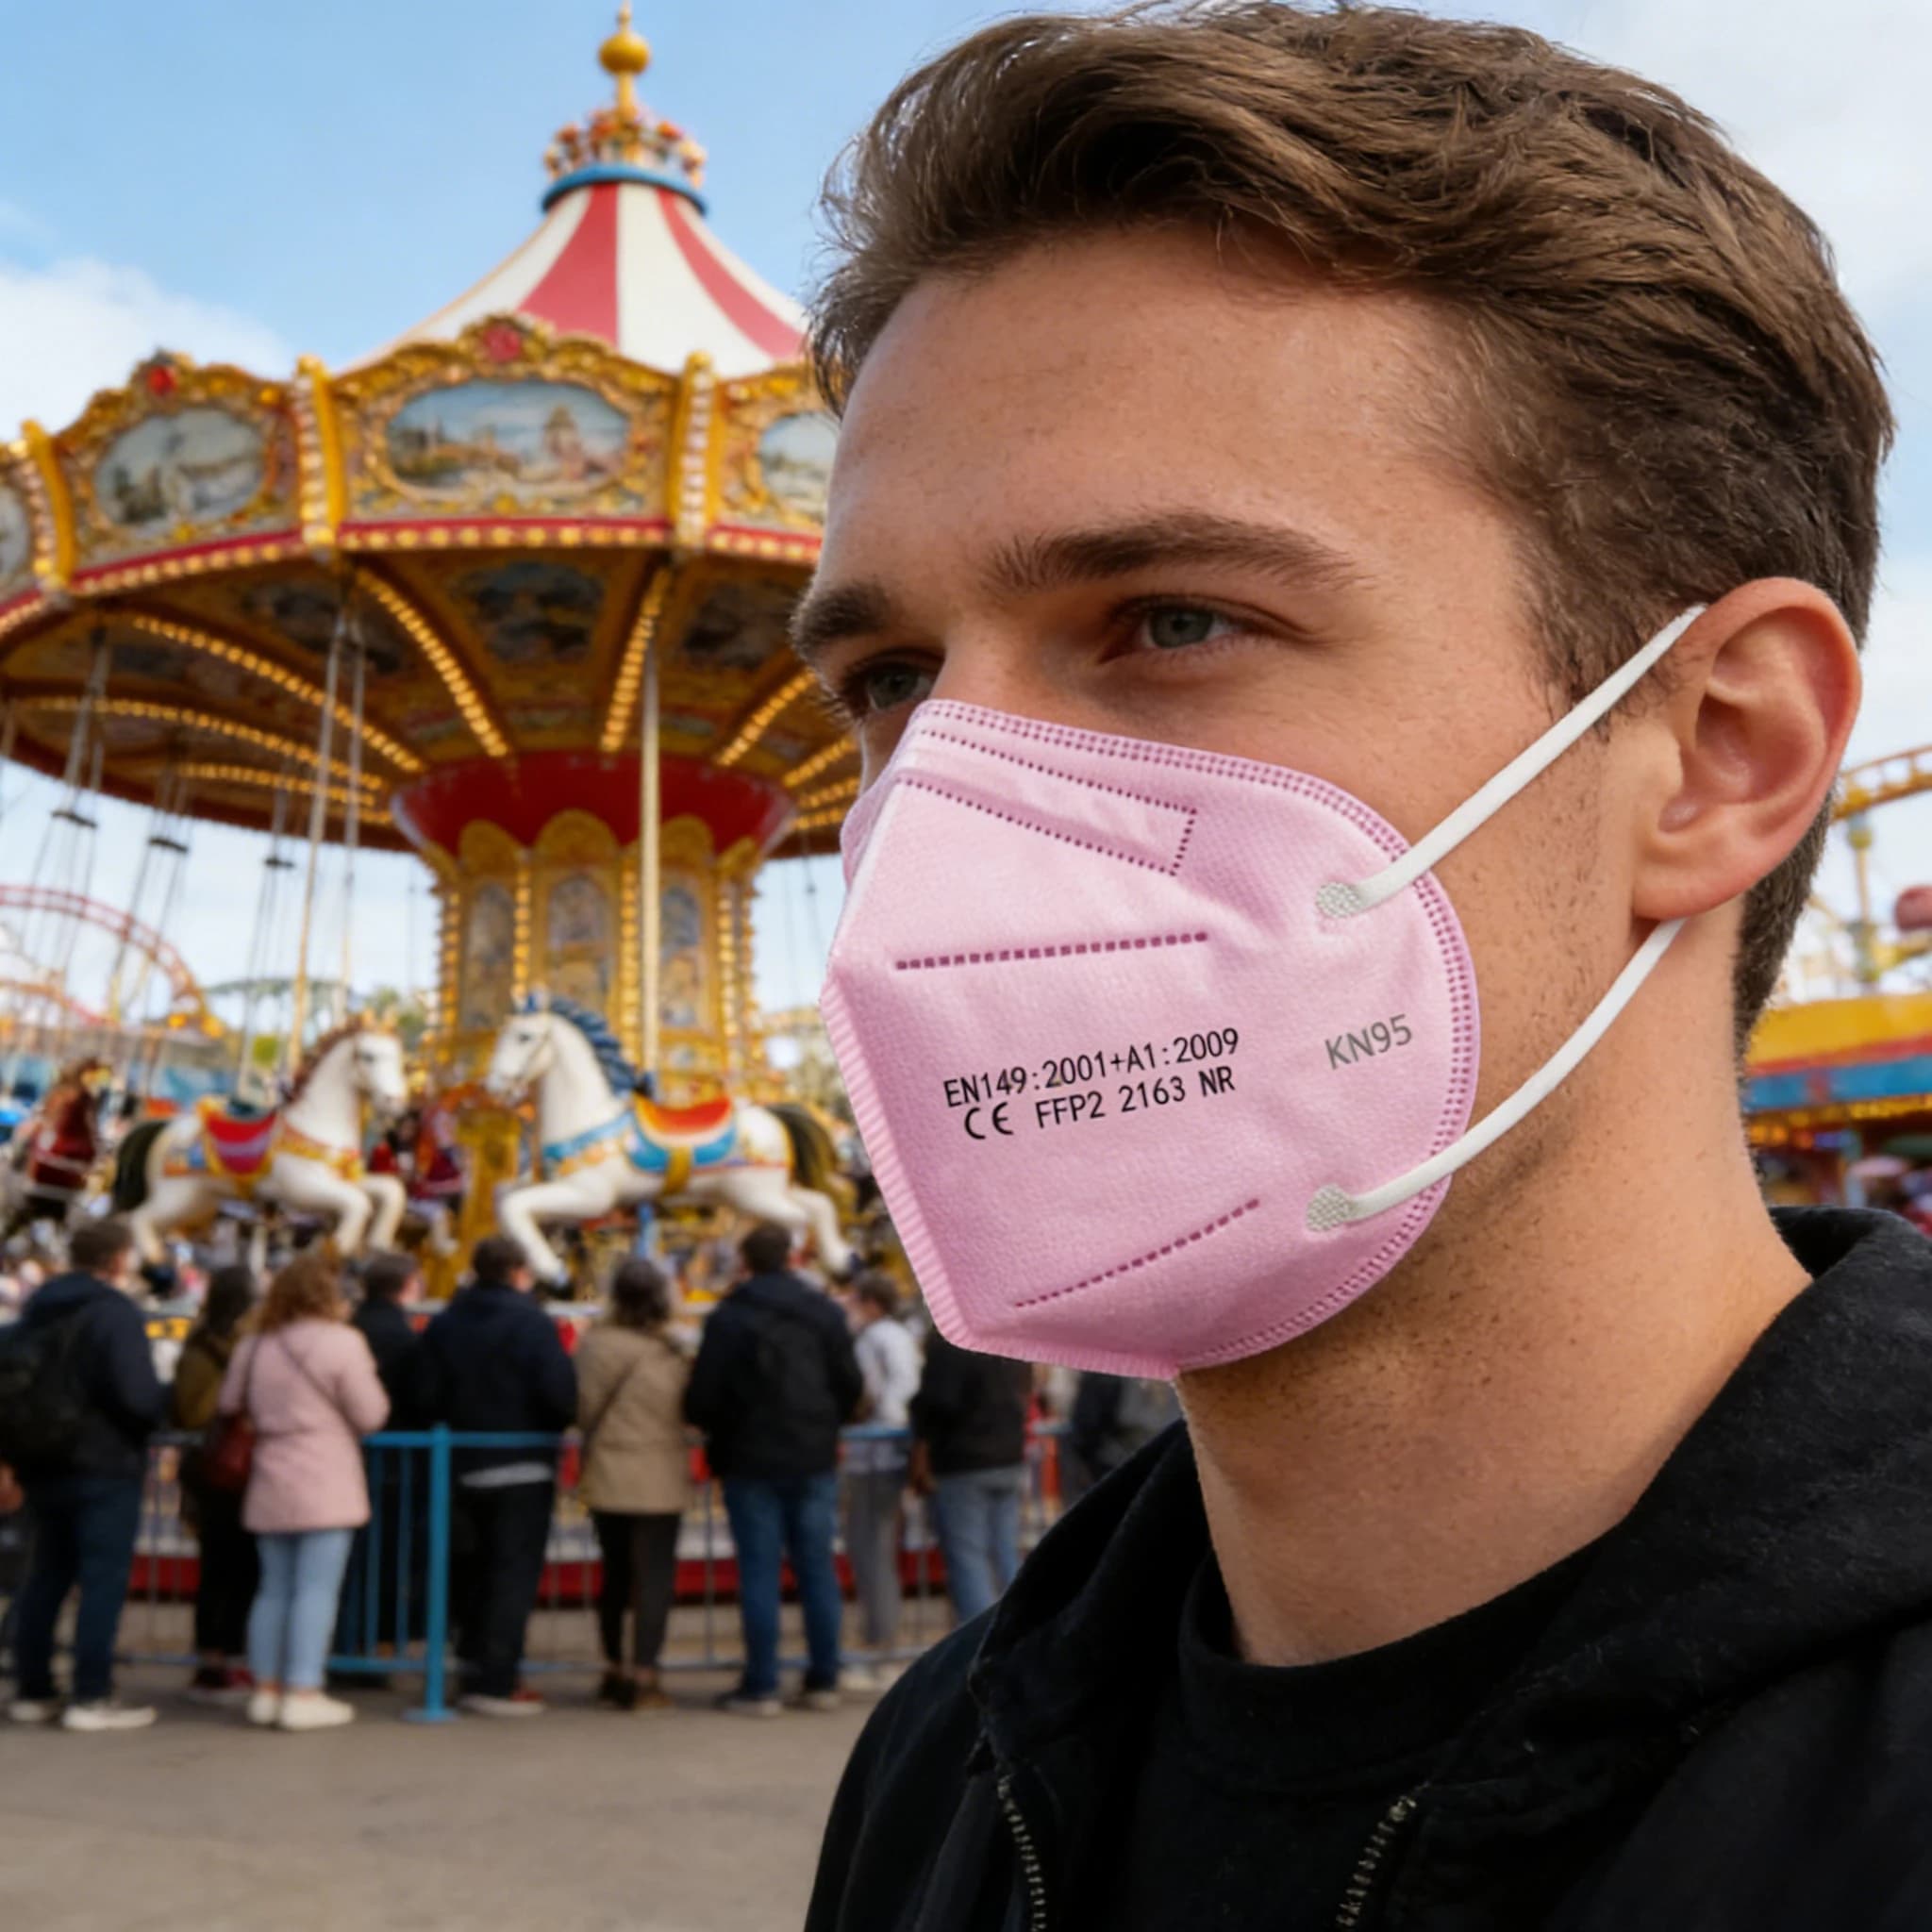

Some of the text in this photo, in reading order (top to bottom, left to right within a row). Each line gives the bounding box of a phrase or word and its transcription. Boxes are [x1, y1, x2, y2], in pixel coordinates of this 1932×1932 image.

[943, 1026, 1240, 1108] EN149:2001+A1:2009
[1325, 1013, 1412, 1069] KN95
[964, 1066, 1236, 1140] CE FFP2 2163 NR
